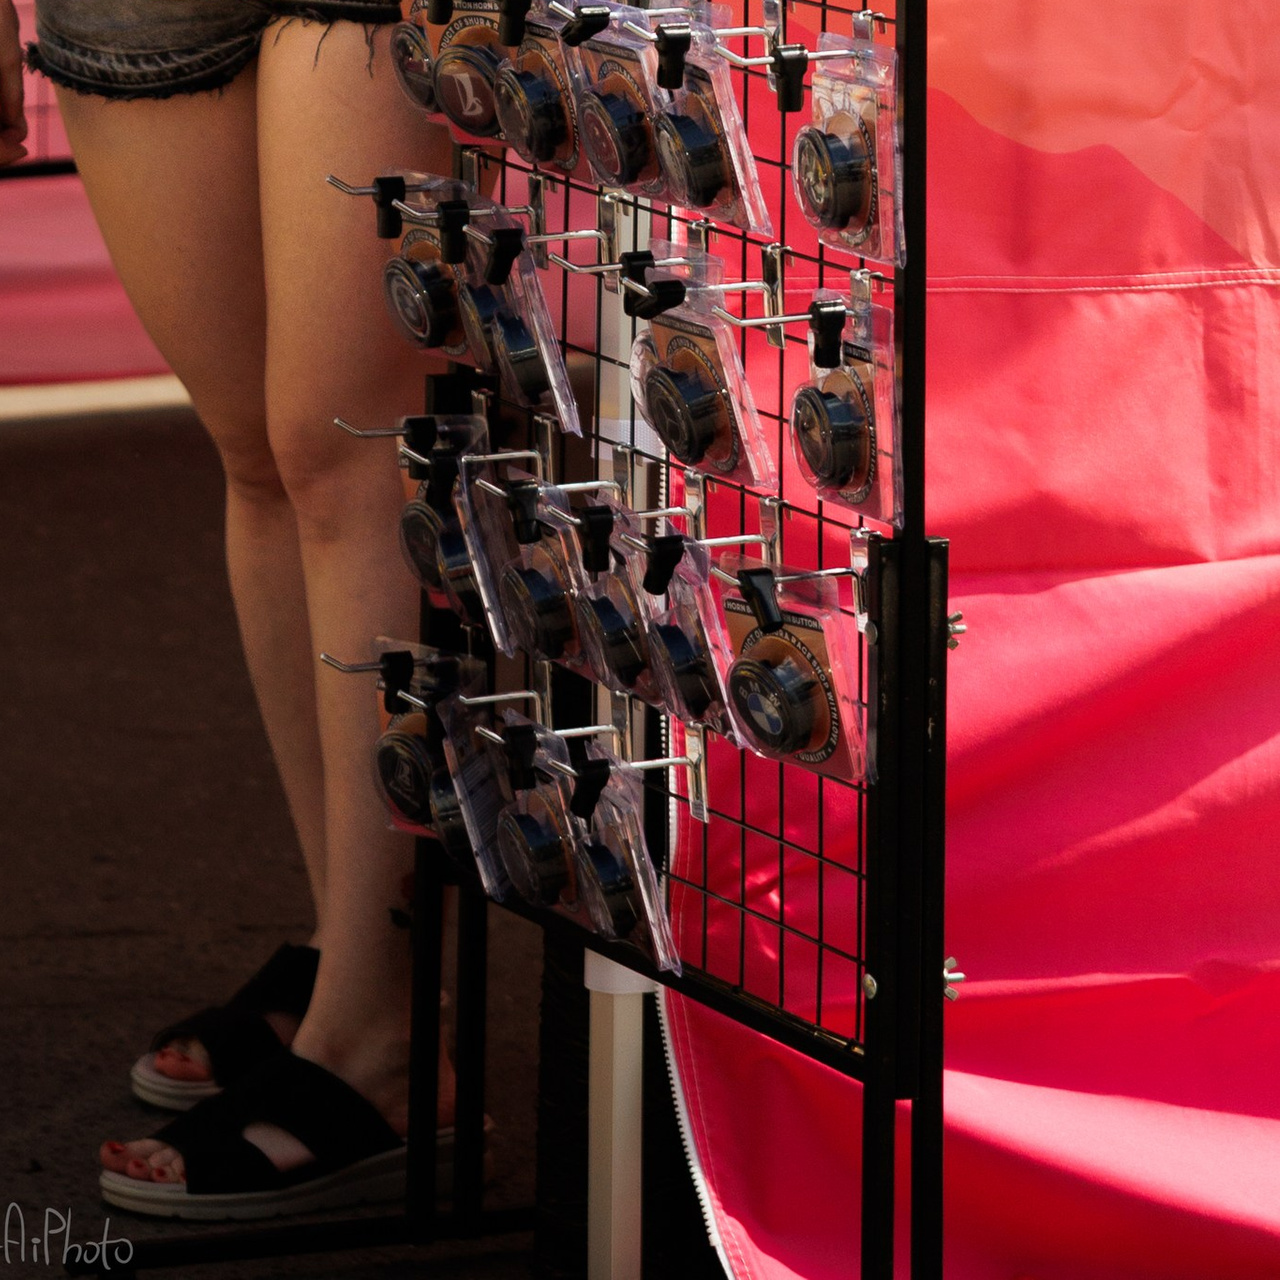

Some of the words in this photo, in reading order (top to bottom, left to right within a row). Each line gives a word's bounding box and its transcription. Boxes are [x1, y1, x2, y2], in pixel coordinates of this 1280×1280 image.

[454, 19, 465, 30] OF
[464, 17, 491, 27] SHURA
[727, 602, 746, 612] HORN
[792, 616, 818, 629] BUTTON
[790, 637, 812, 660] RACE
[811, 659, 829, 690] SHOP
[738, 680, 781, 708] BMW
[826, 691, 838, 721] WITH
[829, 721, 839, 746] LOVE
